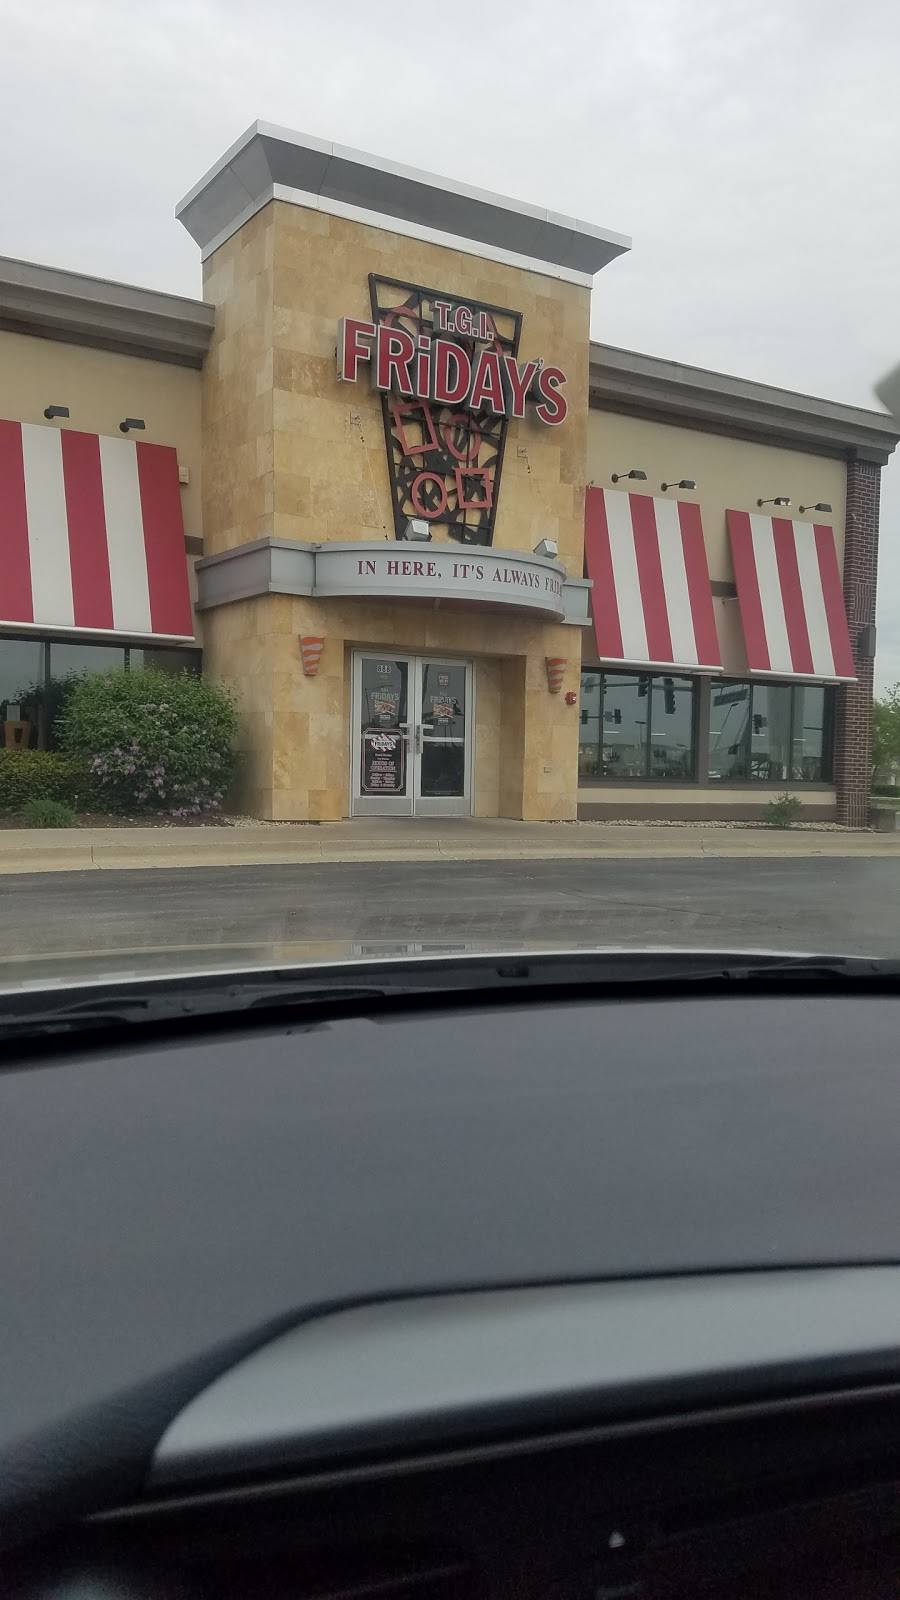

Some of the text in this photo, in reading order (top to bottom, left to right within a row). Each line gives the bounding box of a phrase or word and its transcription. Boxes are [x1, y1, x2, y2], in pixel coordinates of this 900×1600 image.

[434, 300, 496, 341] T.G.I.
[357, 560, 377, 575] IN
[387, 560, 442, 578] HERE,
[452, 563, 484, 580] IT'S
[492, 567, 541, 589] ALWAYS
